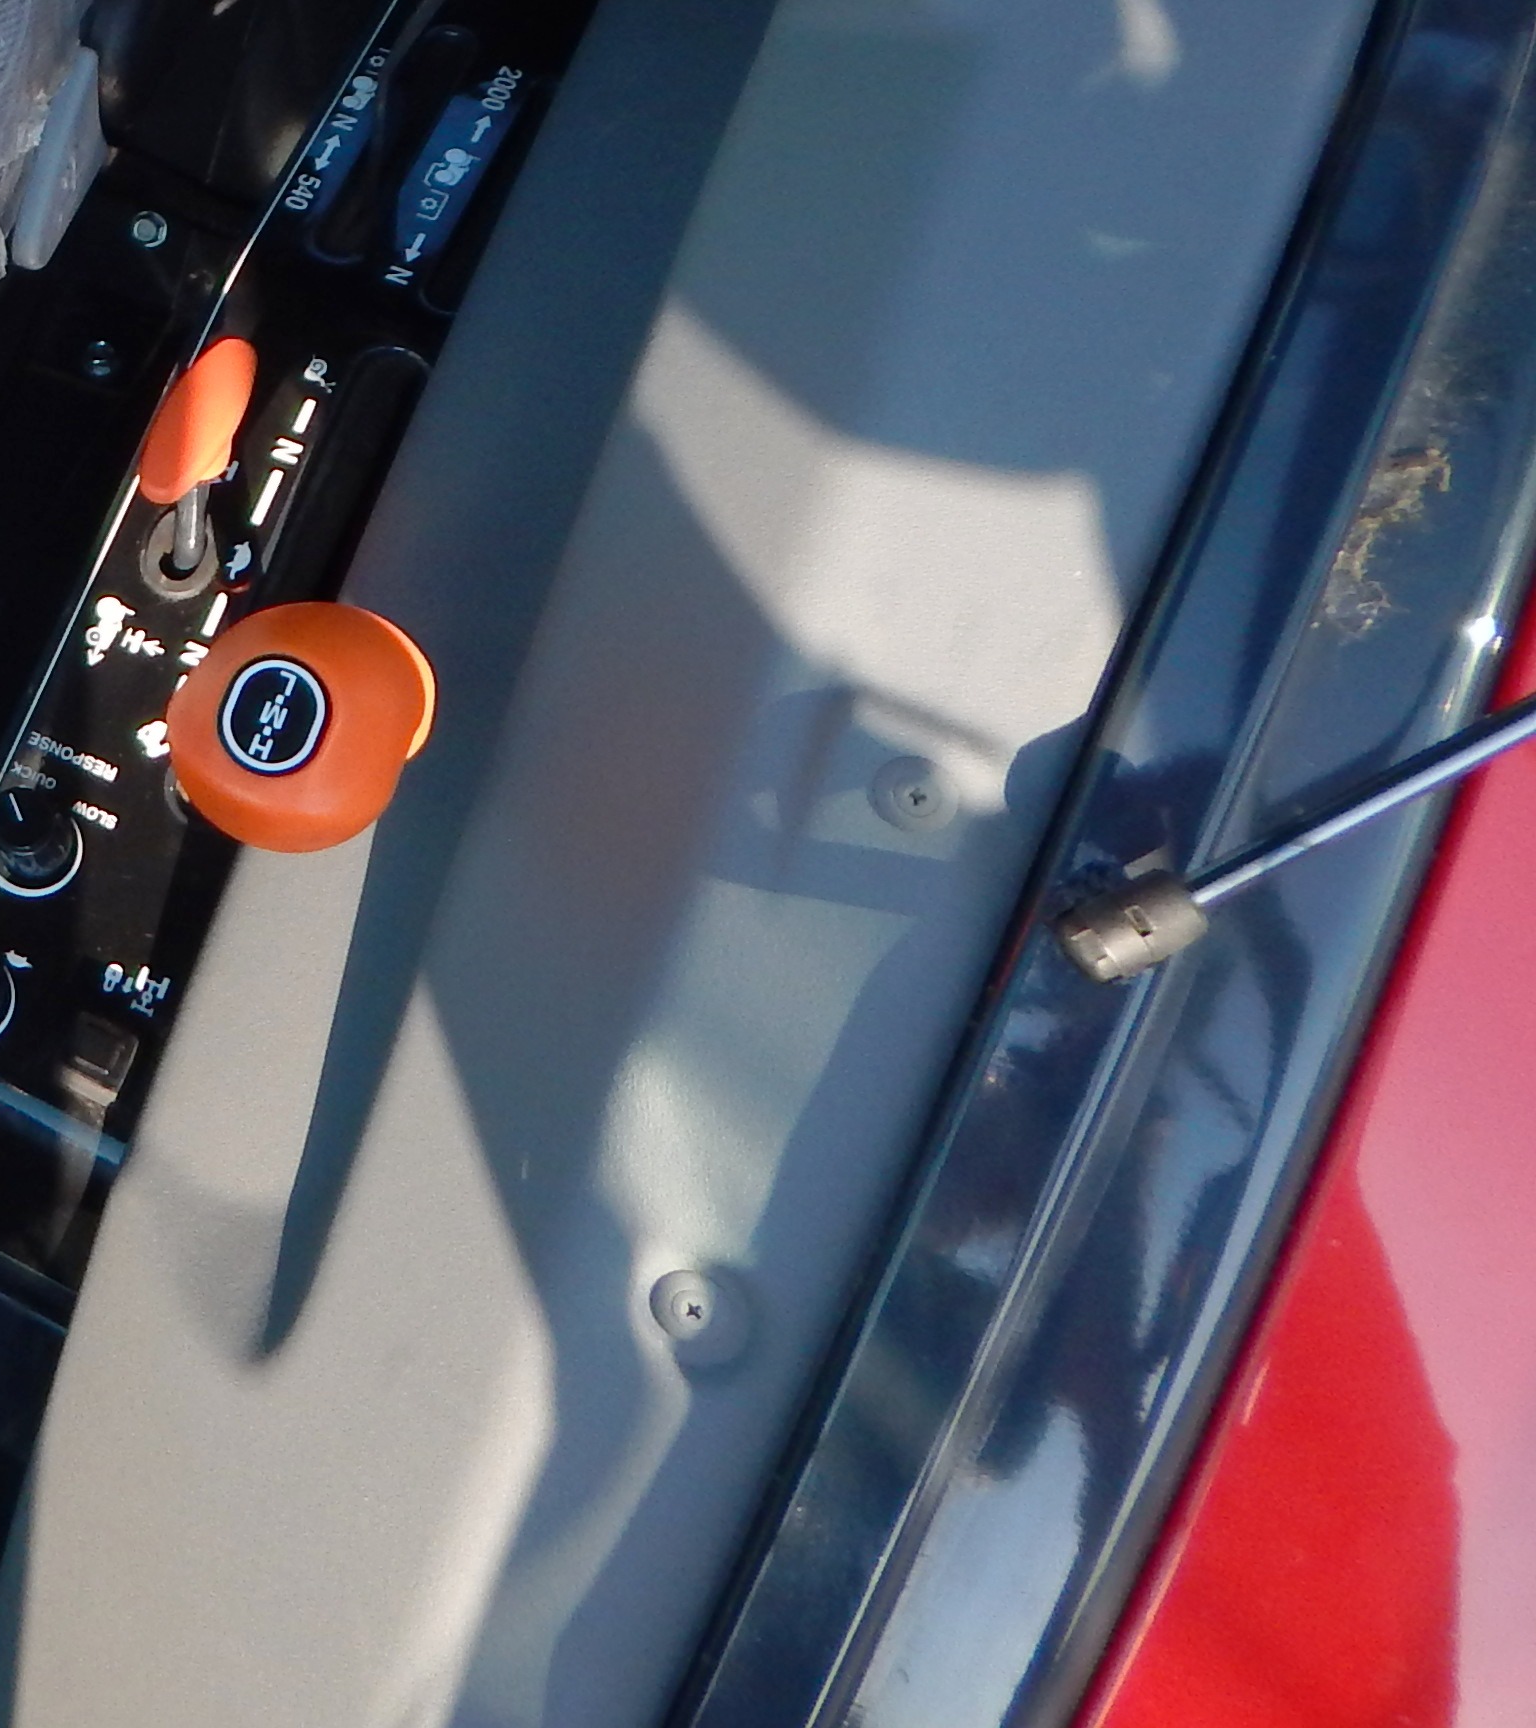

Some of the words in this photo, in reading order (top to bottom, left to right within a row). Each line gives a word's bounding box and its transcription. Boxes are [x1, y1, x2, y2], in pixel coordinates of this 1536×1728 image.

[481, 65, 523, 111] 2000
[331, 113, 358, 131] N
[284, 174, 322, 211] 540
[385, 265, 414, 286] N
[270, 437, 305, 465] N
[179, 640, 210, 666] N
[27, 731, 119, 783] RESPONSE
[10, 761, 57, 790] QUICK
[71, 800, 118, 830] SLOW
